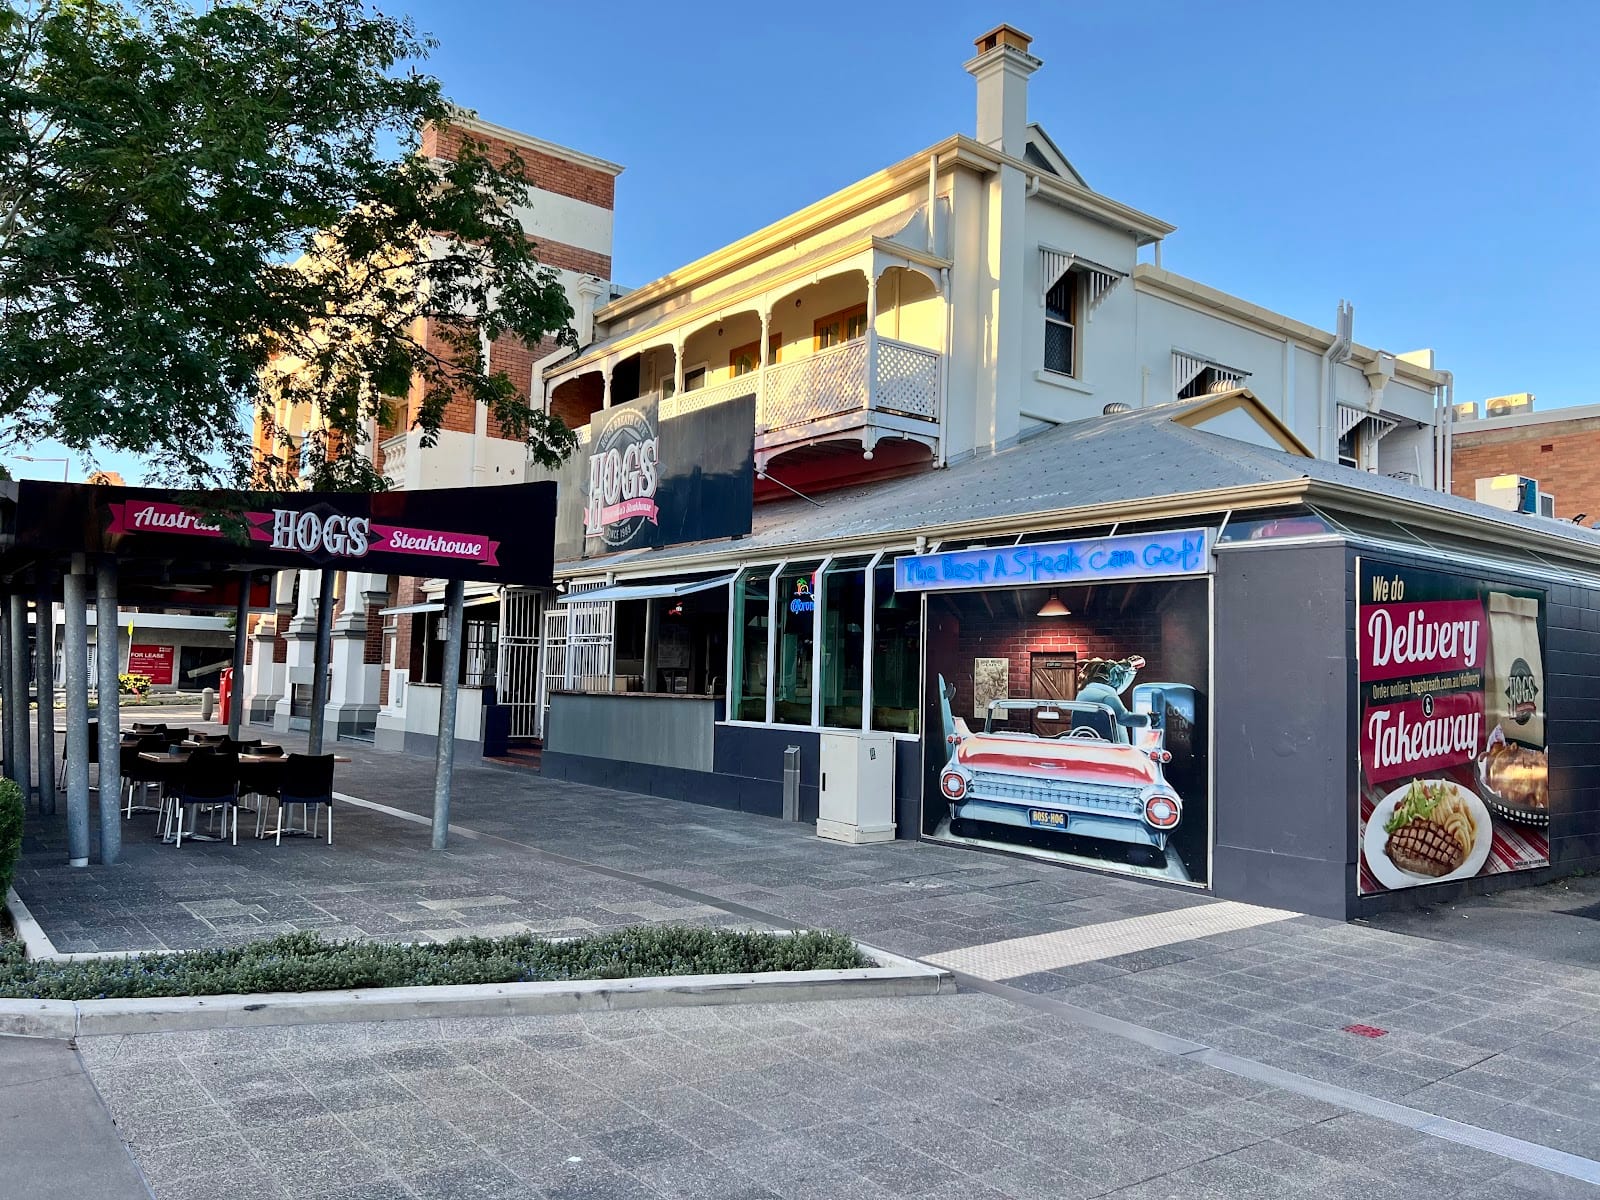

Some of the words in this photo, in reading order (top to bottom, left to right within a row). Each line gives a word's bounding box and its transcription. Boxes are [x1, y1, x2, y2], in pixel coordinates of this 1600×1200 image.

[389, 530, 481, 556] Steakhouse
[904, 559, 937, 583] The
[942, 557, 989, 582] Best
[994, 554, 1008, 578] A
[1009, 548, 1082, 581] Steak
[1089, 550, 1135, 570] Can
[1143, 536, 1204, 571] Get!
[1372, 575, 1389, 602] We
[1391, 574, 1404, 600] do
[1368, 609, 1480, 667] Delivery
[1372, 683, 1389, 699] Order
[1390, 681, 1410, 697] online:
[1410, 672, 1480, 696] hogsbreath.com.au/delivery
[1167, 705, 1193, 717] COOL
[1369, 710, 1481, 768] Takeaway
